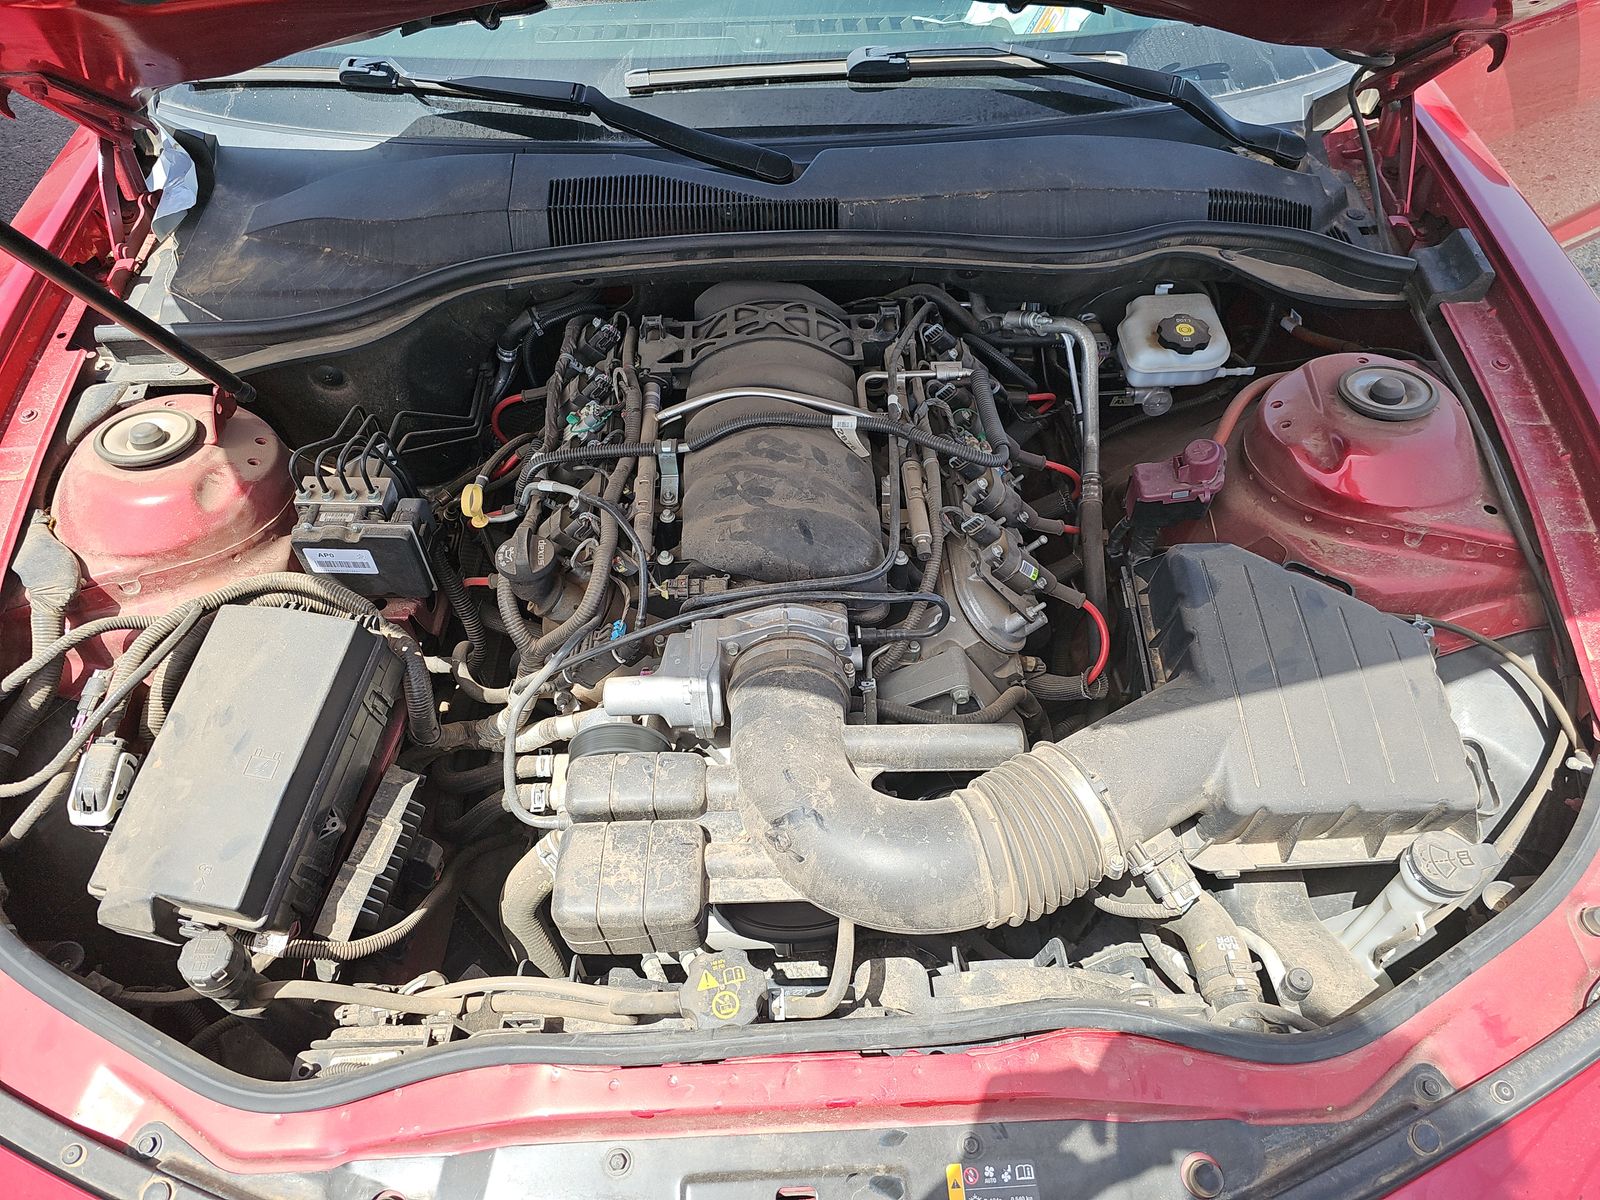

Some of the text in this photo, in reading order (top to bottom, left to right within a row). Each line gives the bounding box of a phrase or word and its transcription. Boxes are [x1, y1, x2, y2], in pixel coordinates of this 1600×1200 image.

[537, 539, 547, 567] dexos
[1216, 935, 1237, 944] UPR
[1217, 942, 1240, 951] RAD
